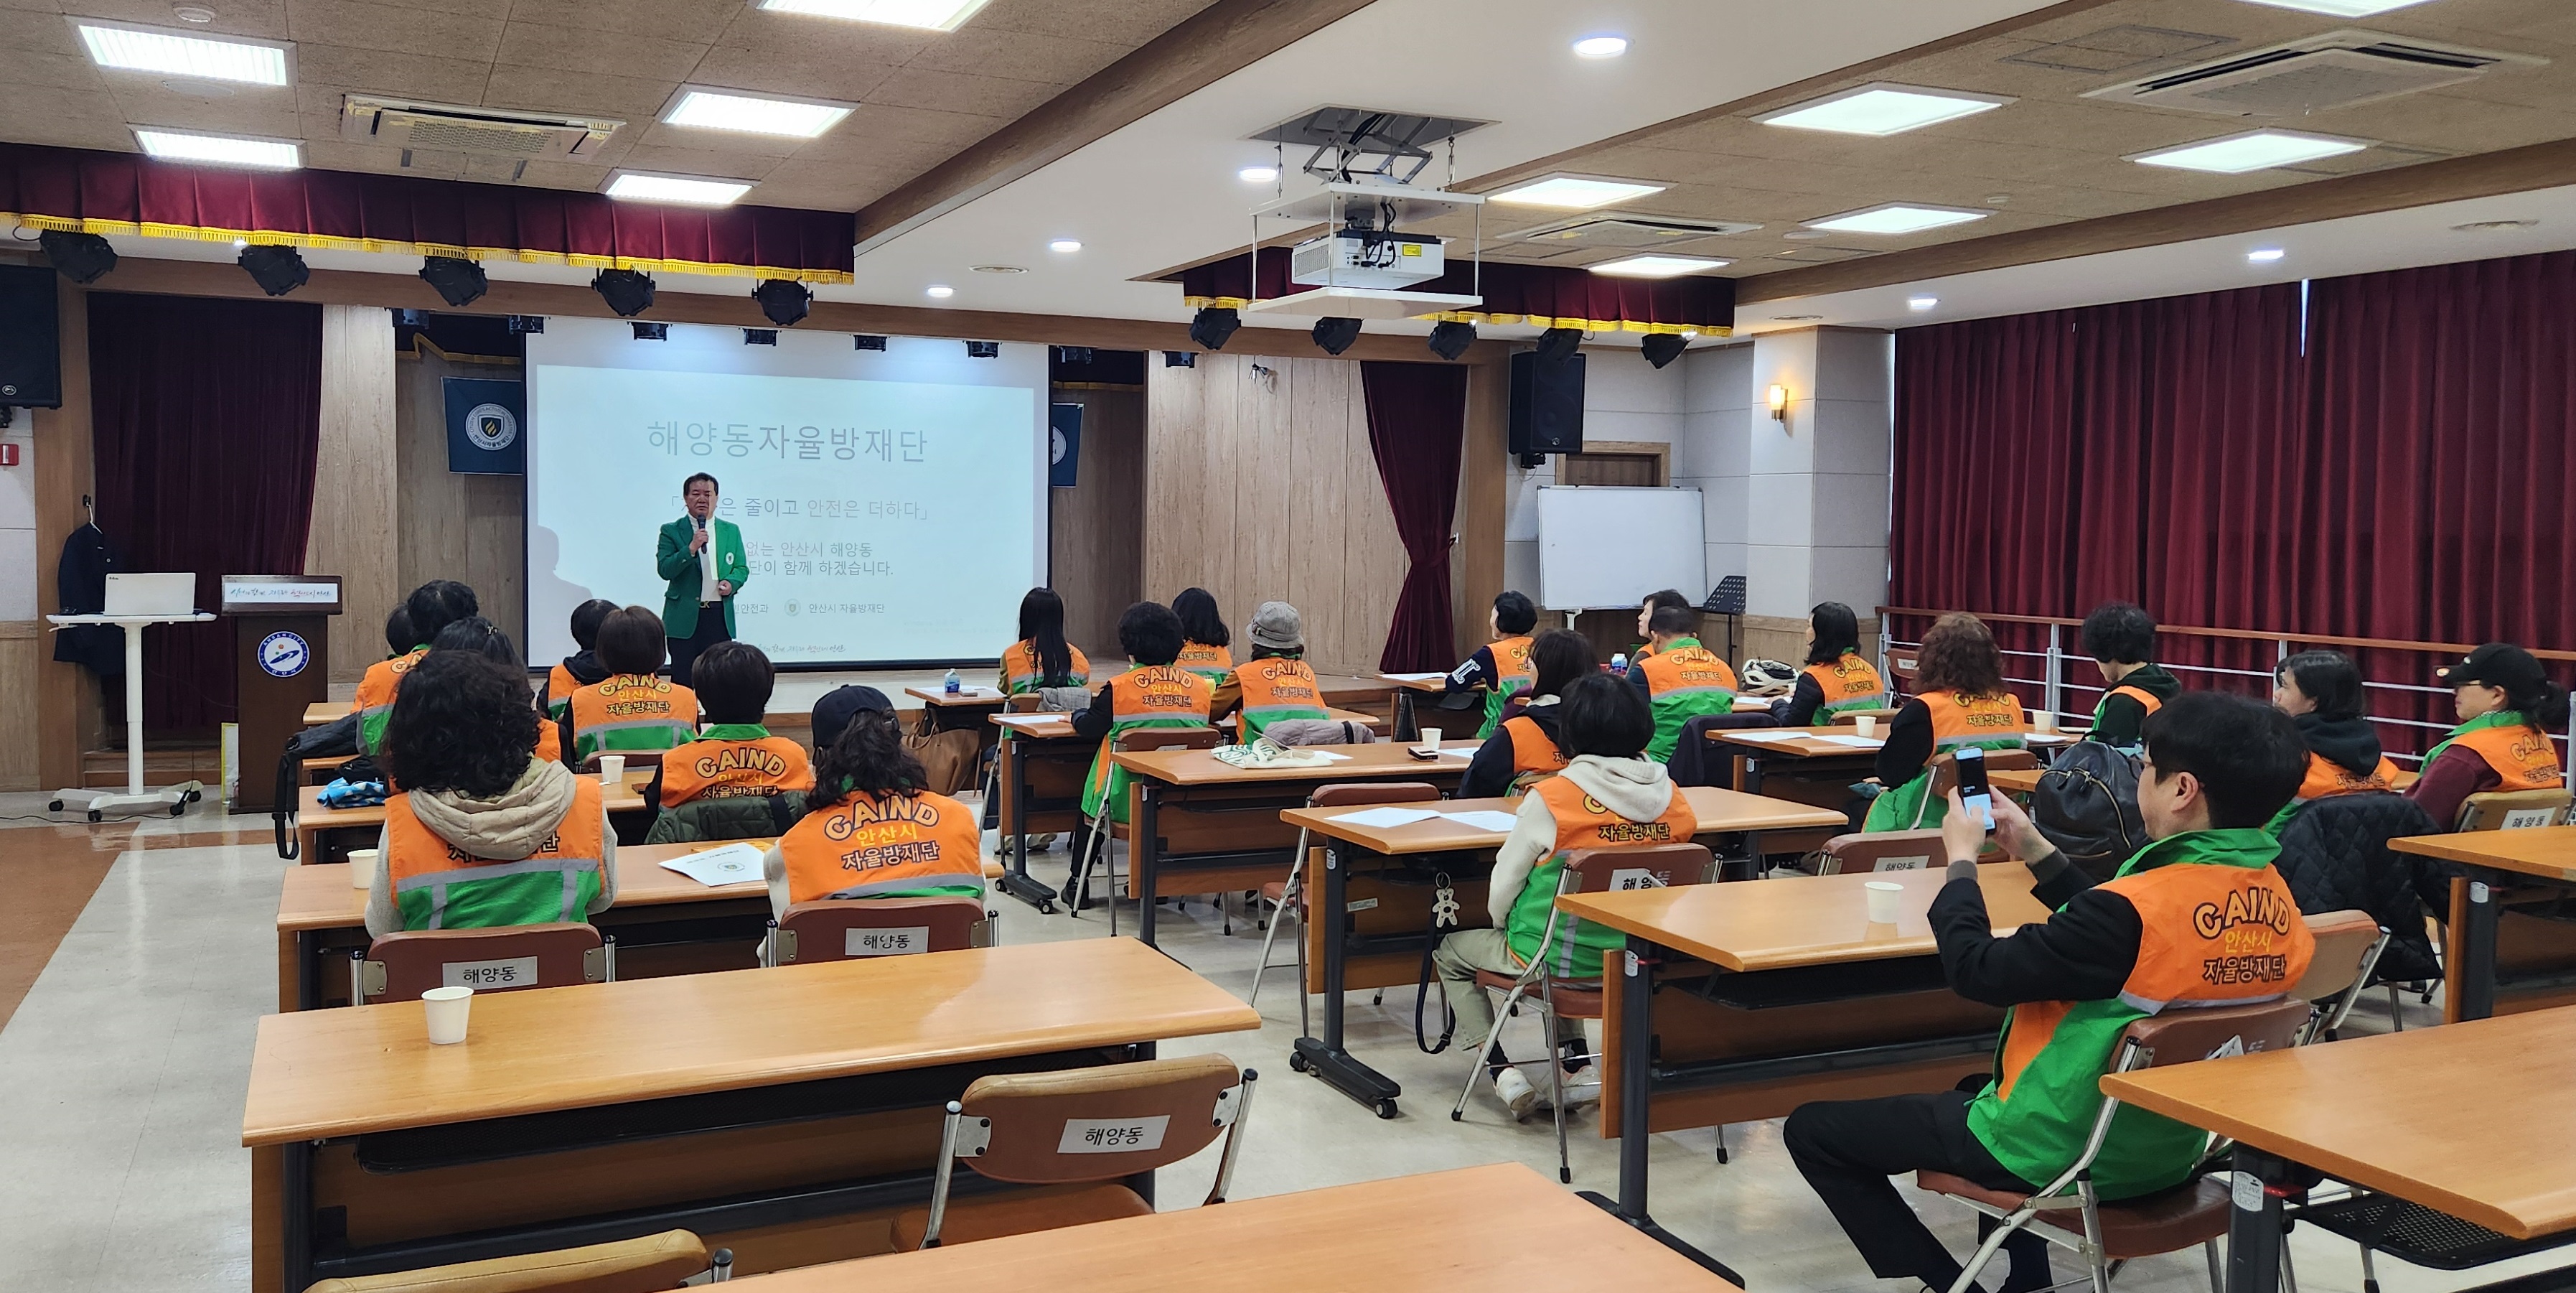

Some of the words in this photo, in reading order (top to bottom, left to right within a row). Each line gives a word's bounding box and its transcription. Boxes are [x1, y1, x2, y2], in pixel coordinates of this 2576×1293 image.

[647, 421, 927, 462] 해양동자율방재단
[744, 497, 800, 518] 줄이고
[807, 498, 861, 520] 안전은
[781, 541, 824, 558] 안산시
[830, 541, 873, 558] 해양동
[783, 559, 812, 576] 함께
[818, 559, 894, 576] 하겠습니다.
[809, 603, 837, 615] 안산시
[840, 603, 885, 615] 자율방재단
[1134, 666, 1194, 688] CAIND
[1261, 660, 1313, 682] CAIND
[599, 674, 672, 696] CAIND
[618, 689, 657, 701] 안산시
[1151, 683, 1182, 695] 안산시
[606, 701, 671, 716] 자율방재단
[1143, 694, 1193, 711] 자율방재단
[1966, 714, 2013, 727] 자율방재단
[695, 747, 786, 779] CAIND
[825, 795, 940, 841] CAIND
[856, 823, 917, 847] 안산시
[1598, 822, 1671, 842] 자율방재단
[841, 840, 940, 872] 자율방재단
[2193, 886, 2290, 940] CAIND
[863, 934, 910, 949] 해양동
[2225, 930, 2272, 953] 안산시
[462, 966, 517, 984] 해양동
[2202, 953, 2287, 985] 자율방재단
[1085, 1125, 1144, 1147] 해양동
